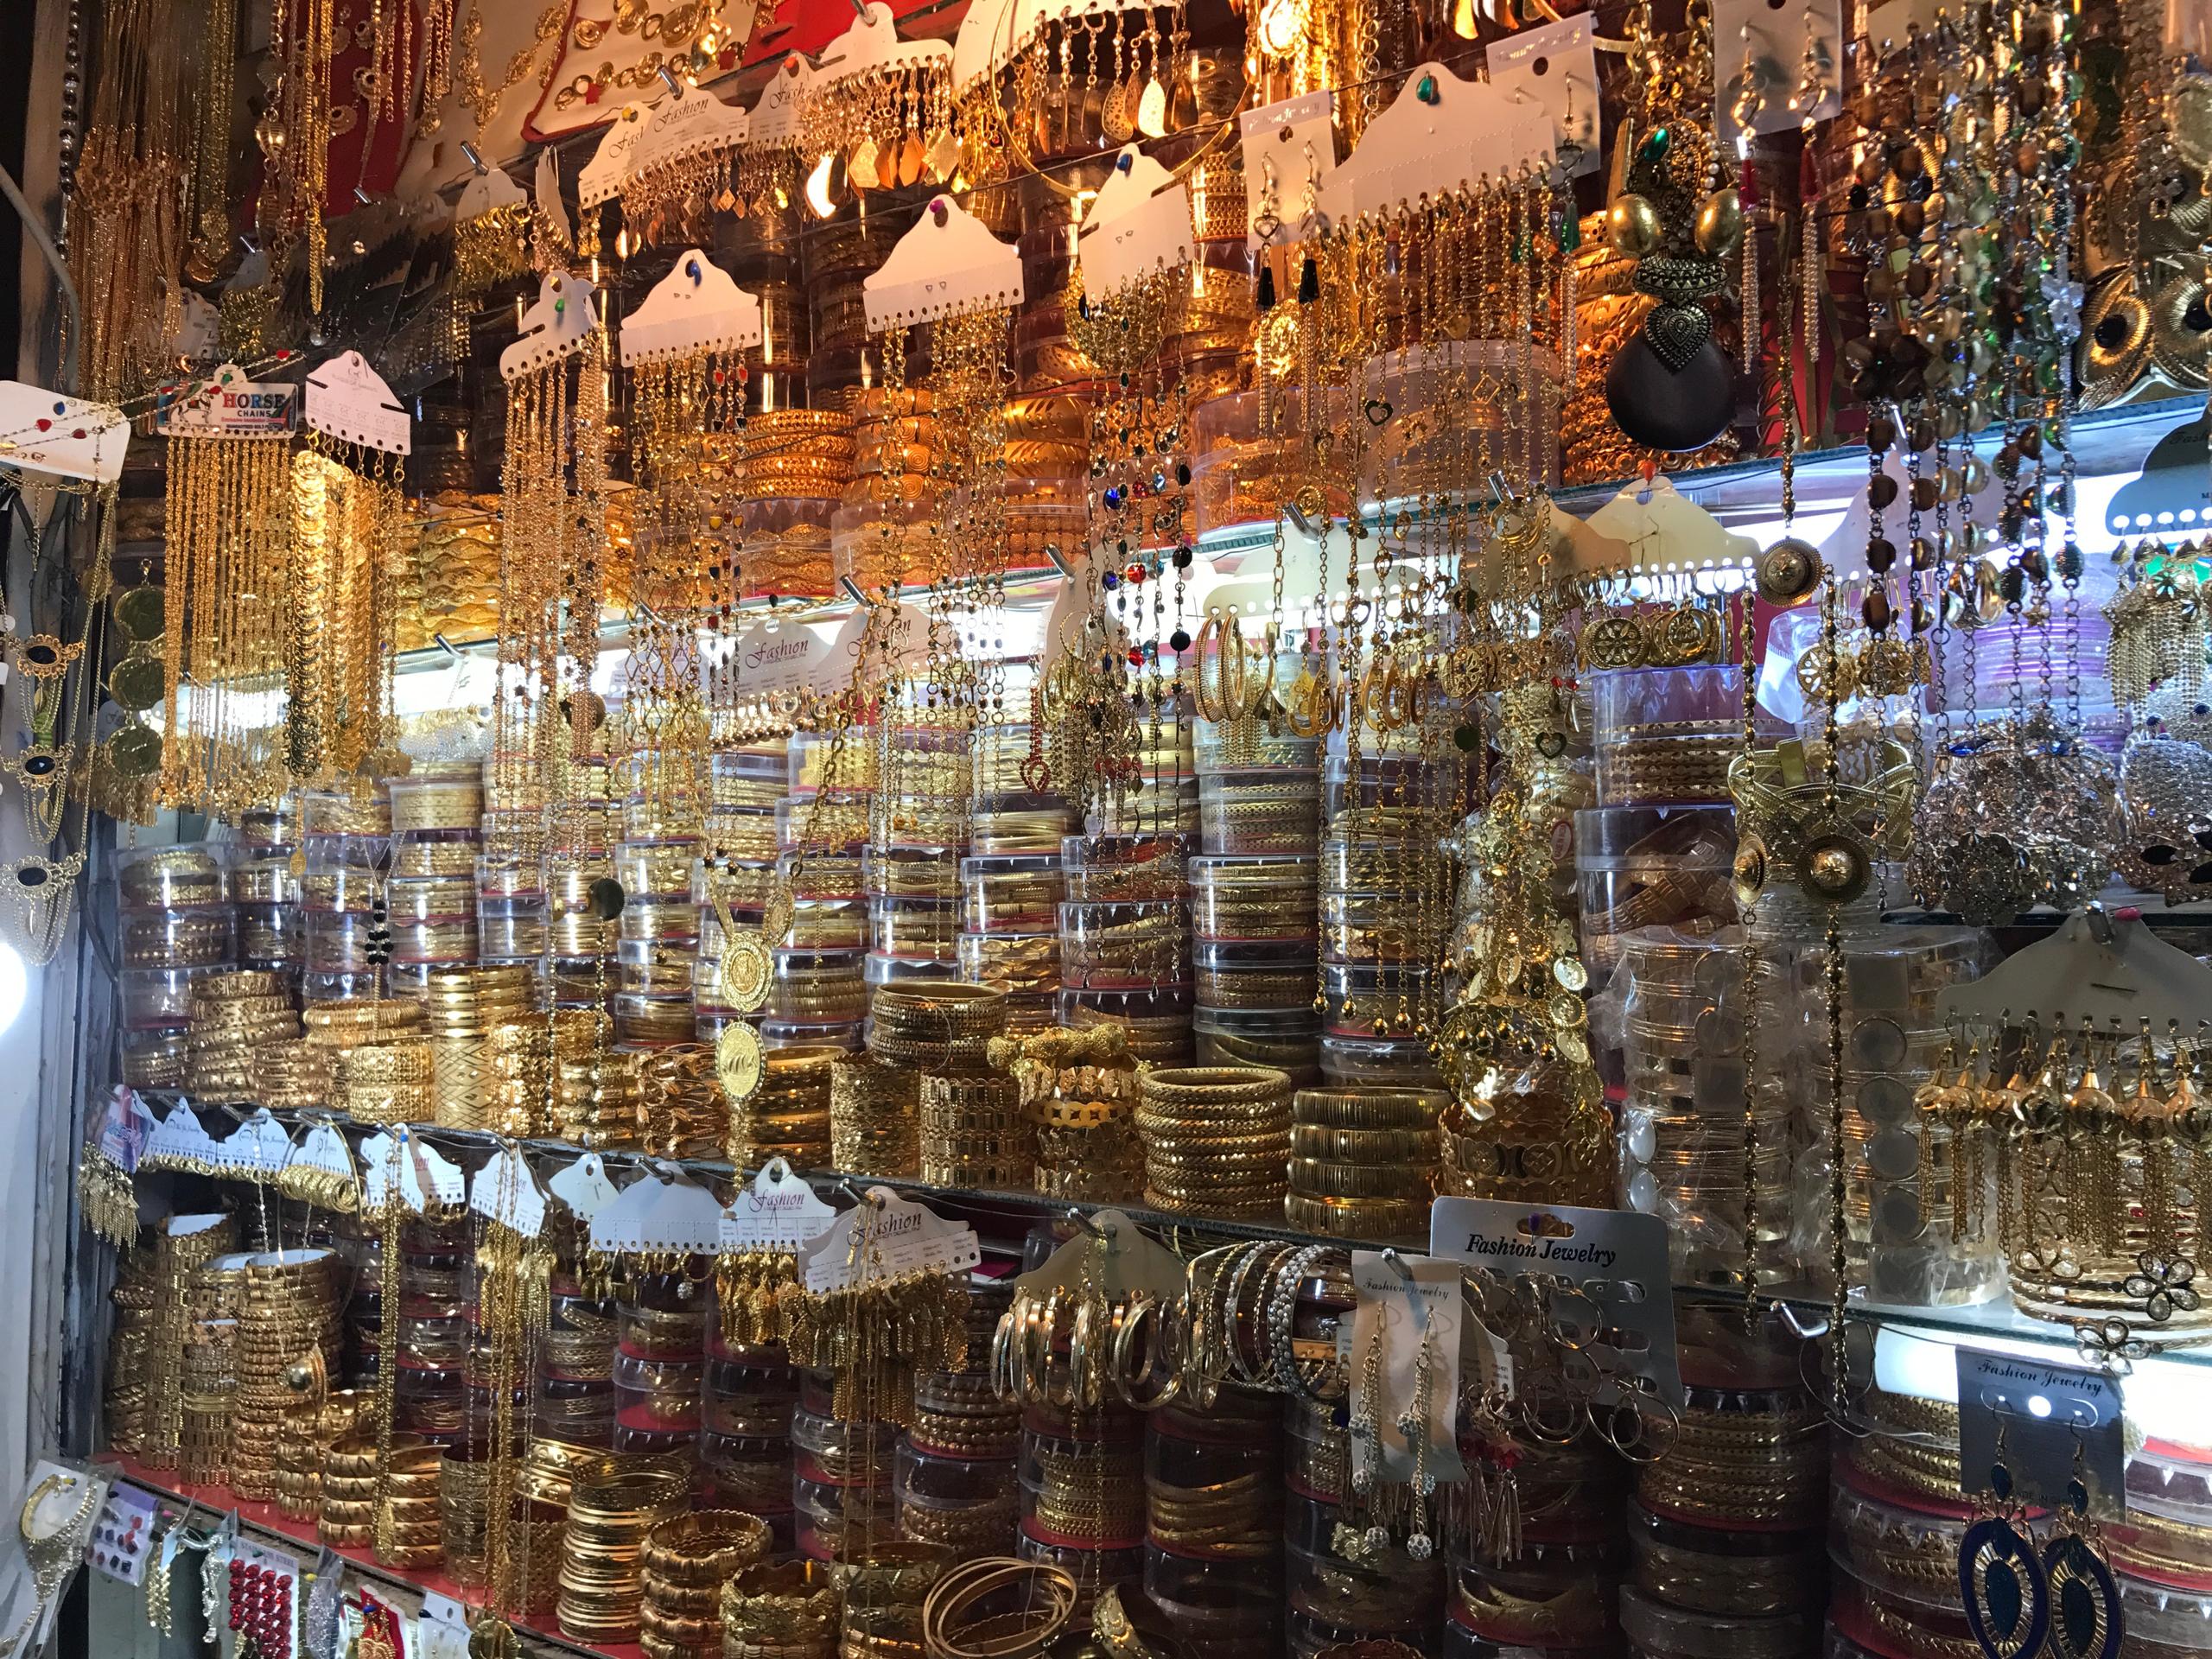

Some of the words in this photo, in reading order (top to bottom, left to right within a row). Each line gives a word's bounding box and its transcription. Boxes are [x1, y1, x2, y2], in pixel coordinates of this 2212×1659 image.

[653, 98, 709, 133] Fashion
[222, 392, 285, 409] HORSE
[745, 639, 809, 669] Fashion
[747, 1188, 805, 1212] Fashion
[1465, 1233, 1537, 1257] Fashion
[1539, 1239, 1617, 1268] Jewelry
[1363, 1278, 1406, 1293] Fashion
[1408, 1281, 1450, 1301] Jewelry
[1977, 1359, 2037, 1381] Fashion
[2040, 1370, 2102, 1396] Jewelry
